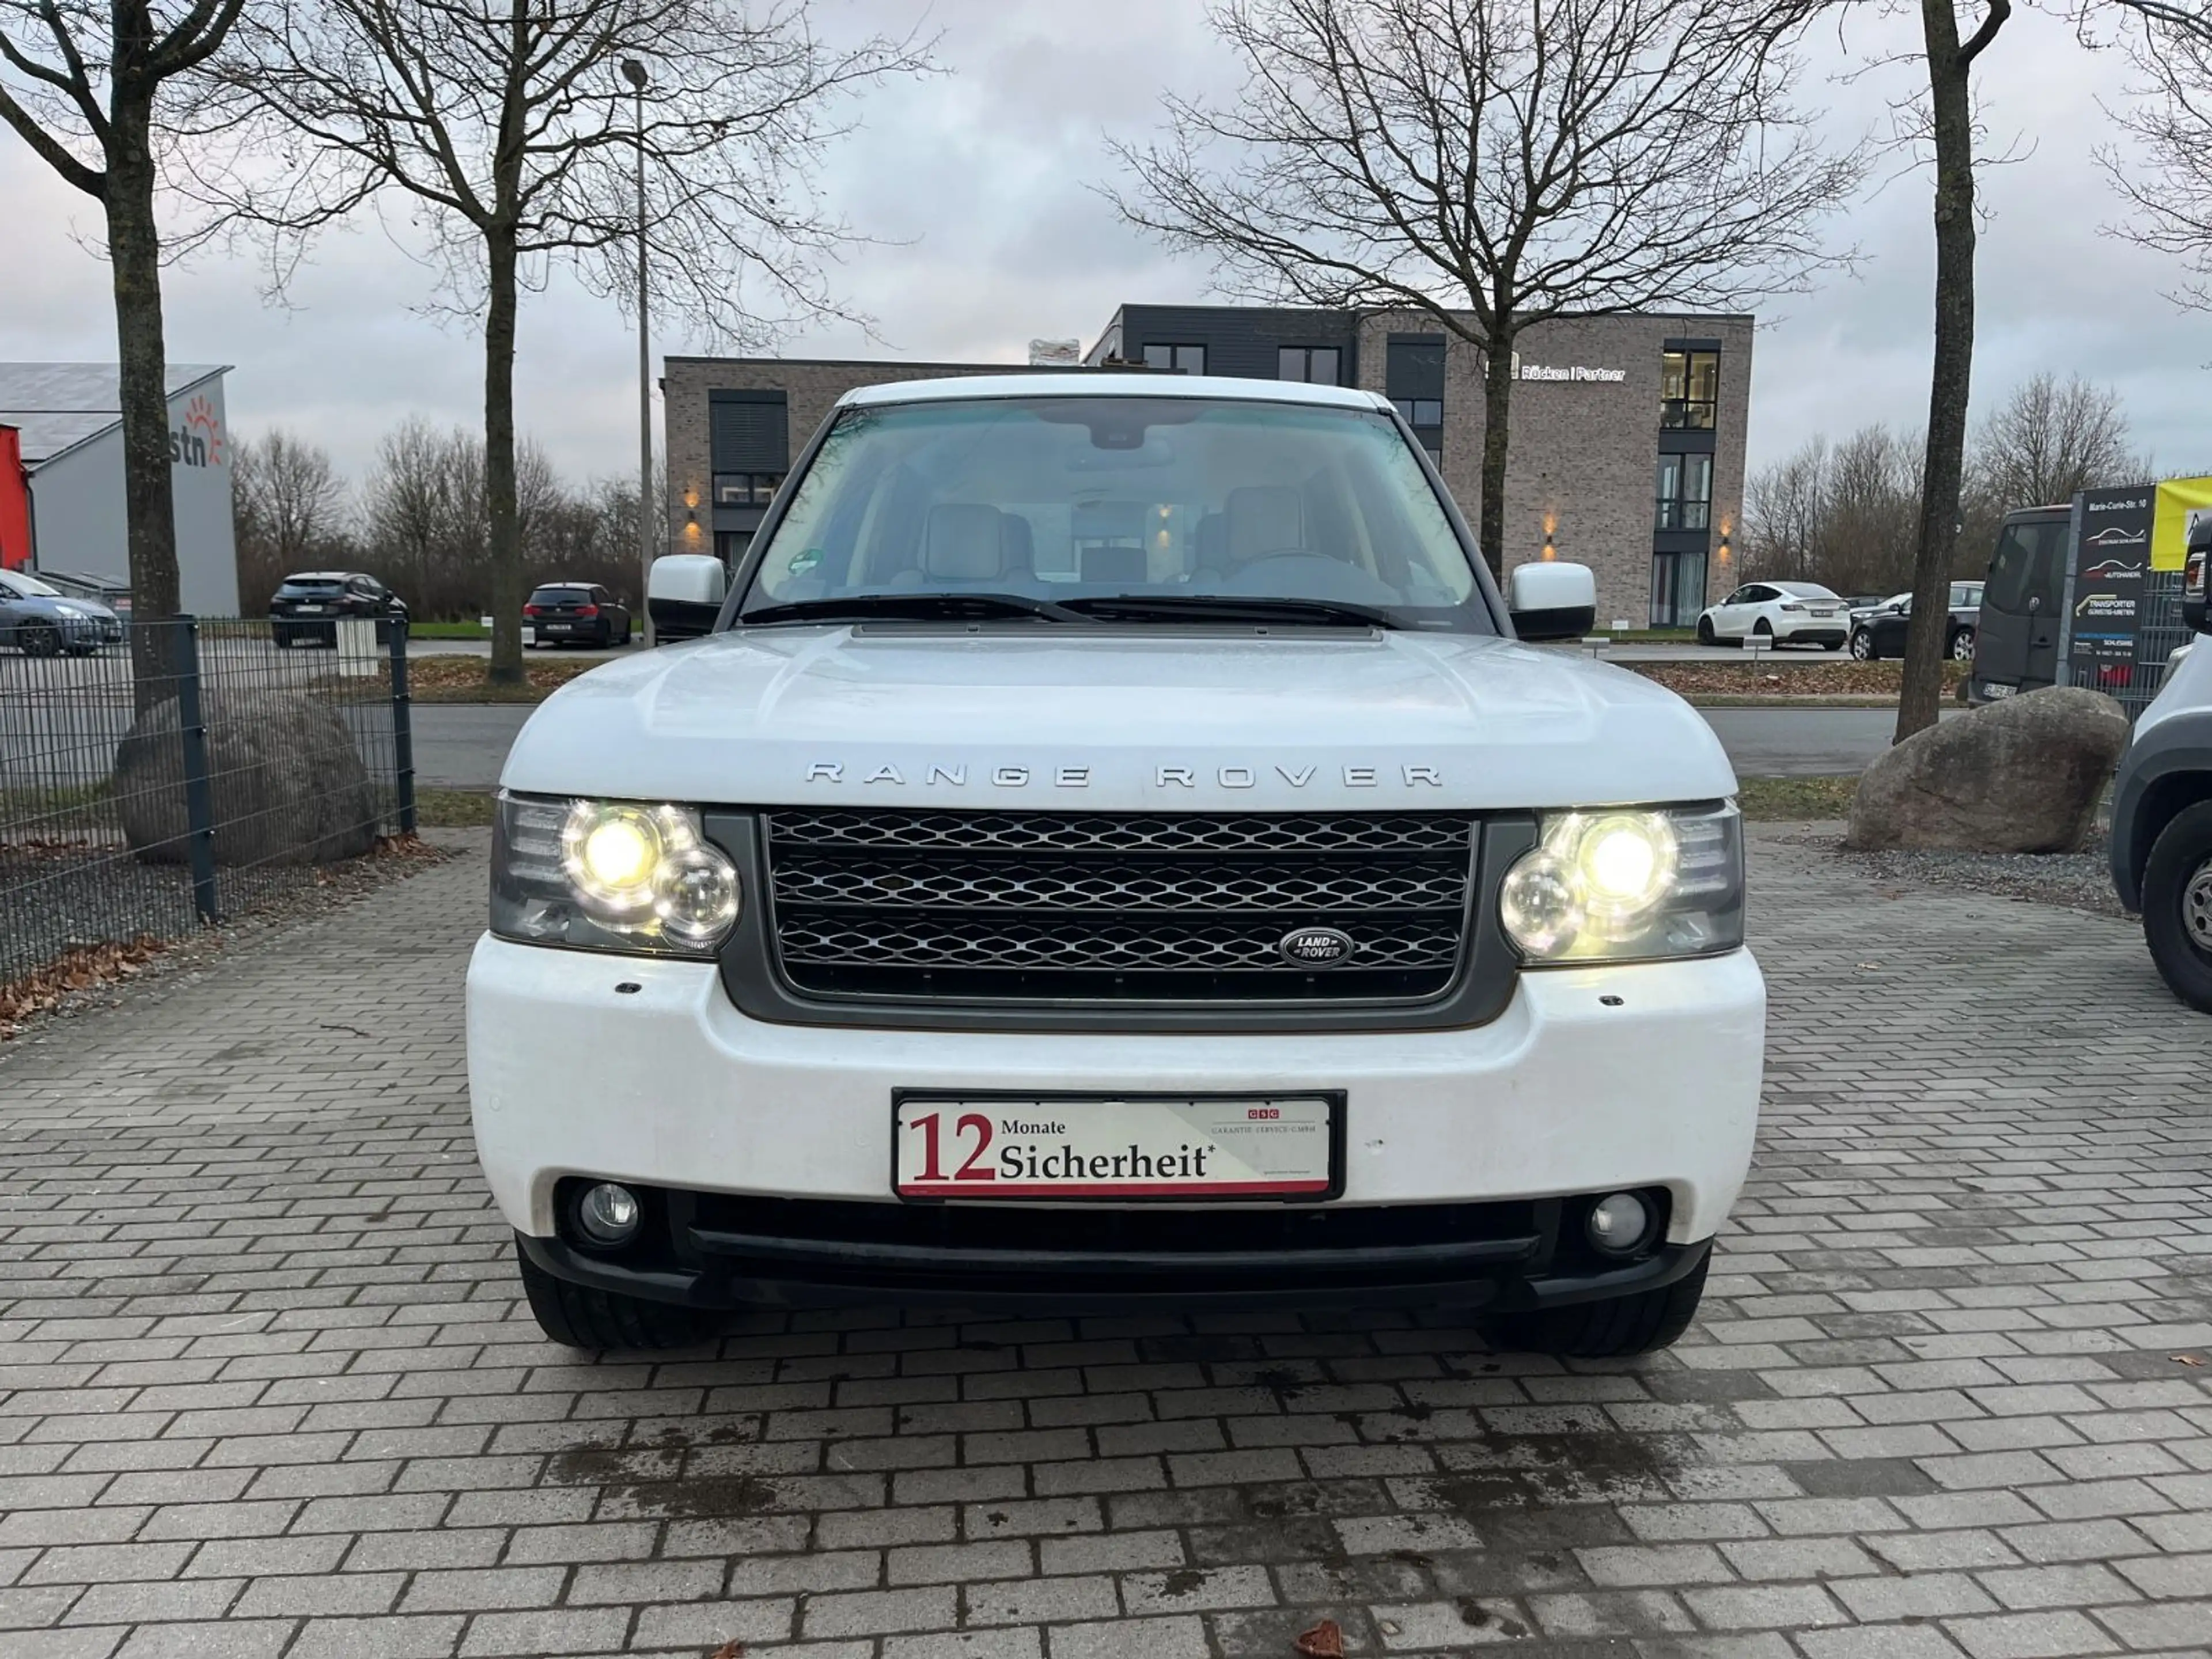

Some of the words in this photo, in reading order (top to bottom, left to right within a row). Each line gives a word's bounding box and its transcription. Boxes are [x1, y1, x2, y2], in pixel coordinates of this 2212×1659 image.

[1575, 366, 1626, 381] Partner
[2089, 600, 2135, 608] TRANSPORTER
[806, 762, 1089, 787] RANGE
[1156, 763, 1442, 788] ROVER
[910, 1112, 995, 1180] 12
[1001, 1120, 1066, 1134] Monate
